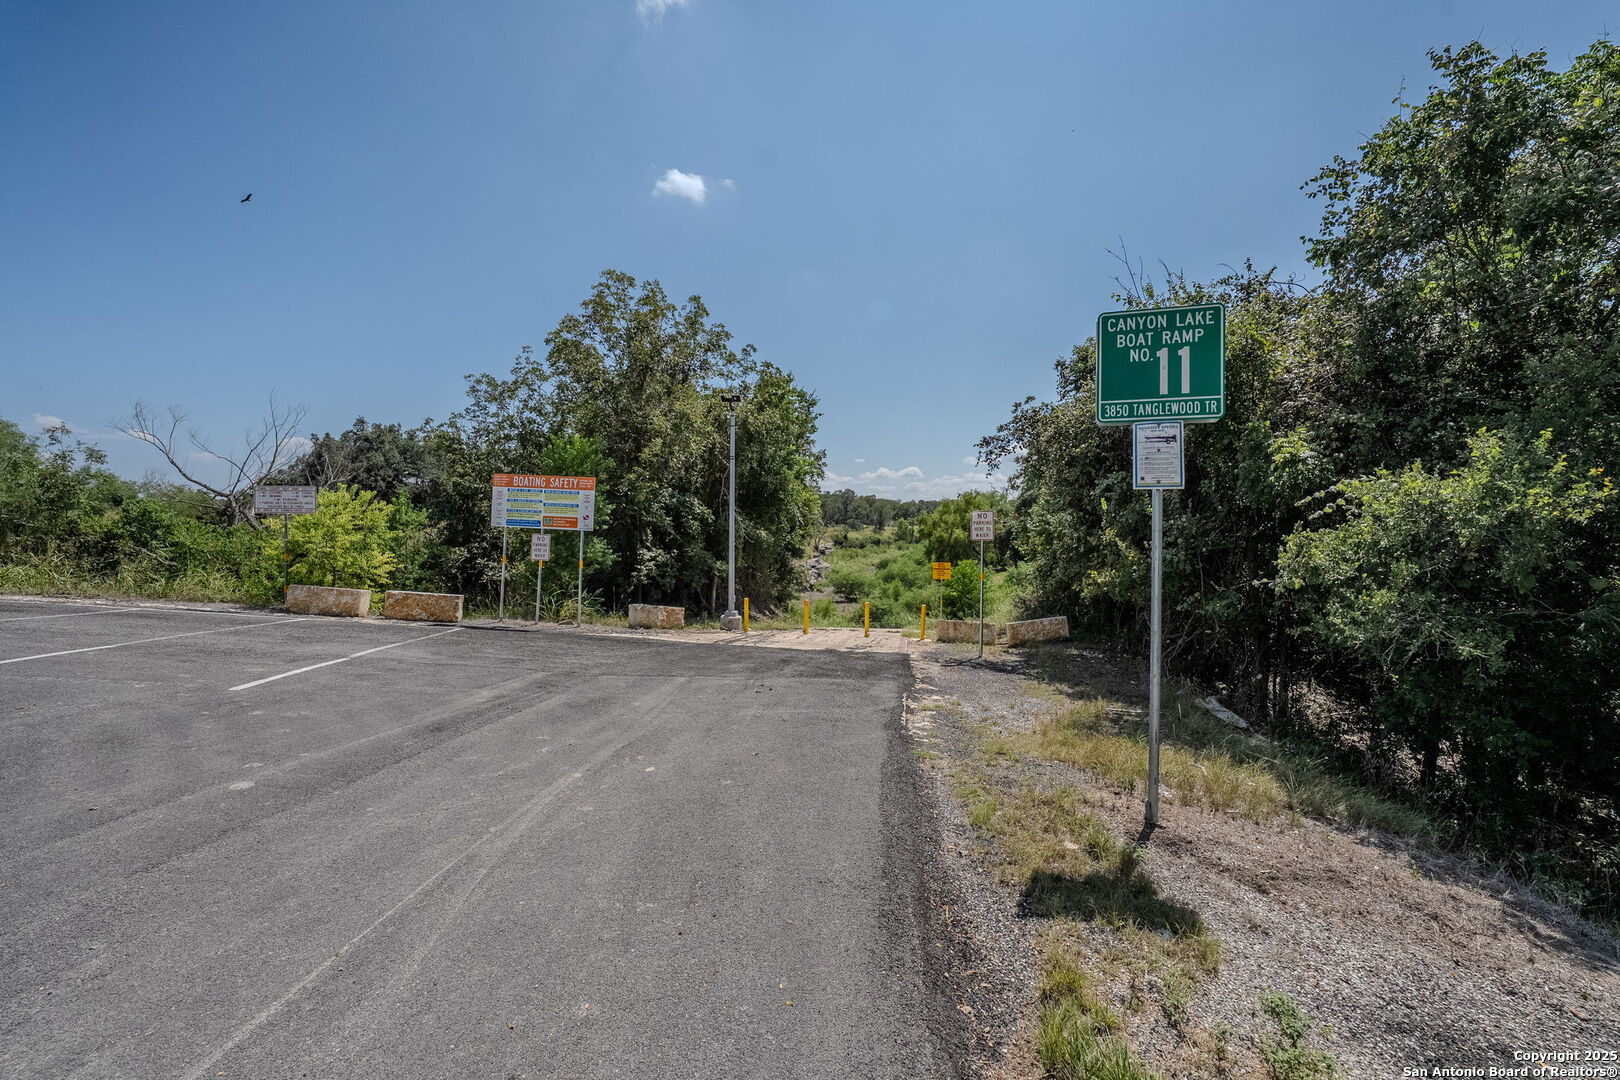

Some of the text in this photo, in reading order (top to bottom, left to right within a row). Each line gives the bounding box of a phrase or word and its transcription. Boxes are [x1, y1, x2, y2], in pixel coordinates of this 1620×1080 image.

[1108, 311, 1214, 332] CANYON LAKE
[1117, 329, 1204, 347] BOAT RAMP
[1130, 346, 1190, 395] NO. 11
[1105, 401, 1217, 417] 3850 TANGLEWOOD TR
[513, 476, 546, 487] BOATING
[550, 477, 578, 488] SAFETY
